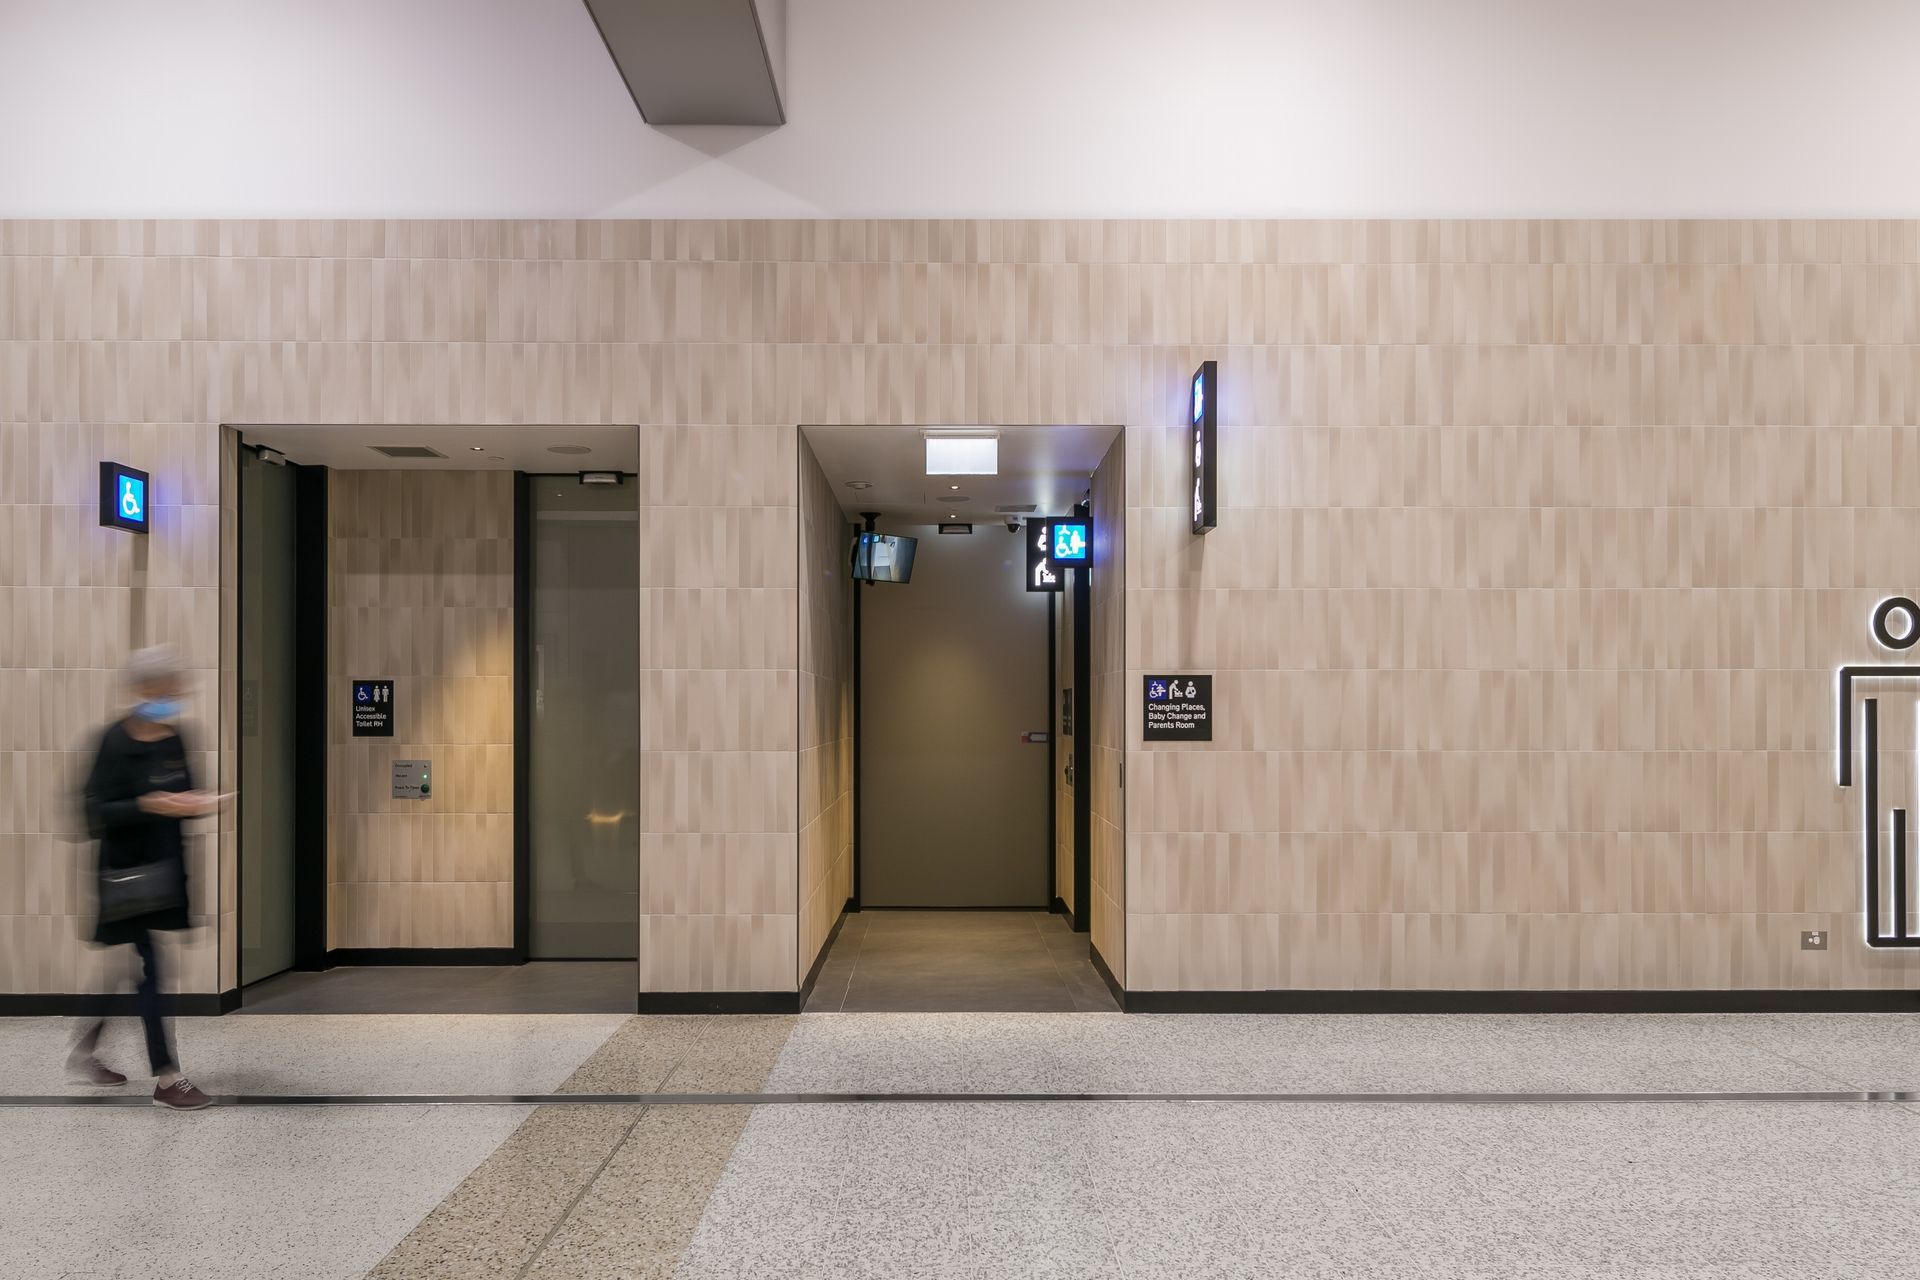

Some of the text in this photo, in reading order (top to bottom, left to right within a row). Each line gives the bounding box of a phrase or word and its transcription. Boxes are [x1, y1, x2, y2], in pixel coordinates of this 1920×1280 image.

[1148, 703, 1206, 712] Changing Places,
[1148, 712, 1206, 721] Baby Change and
[1148, 721, 1195, 729] Parents Room
